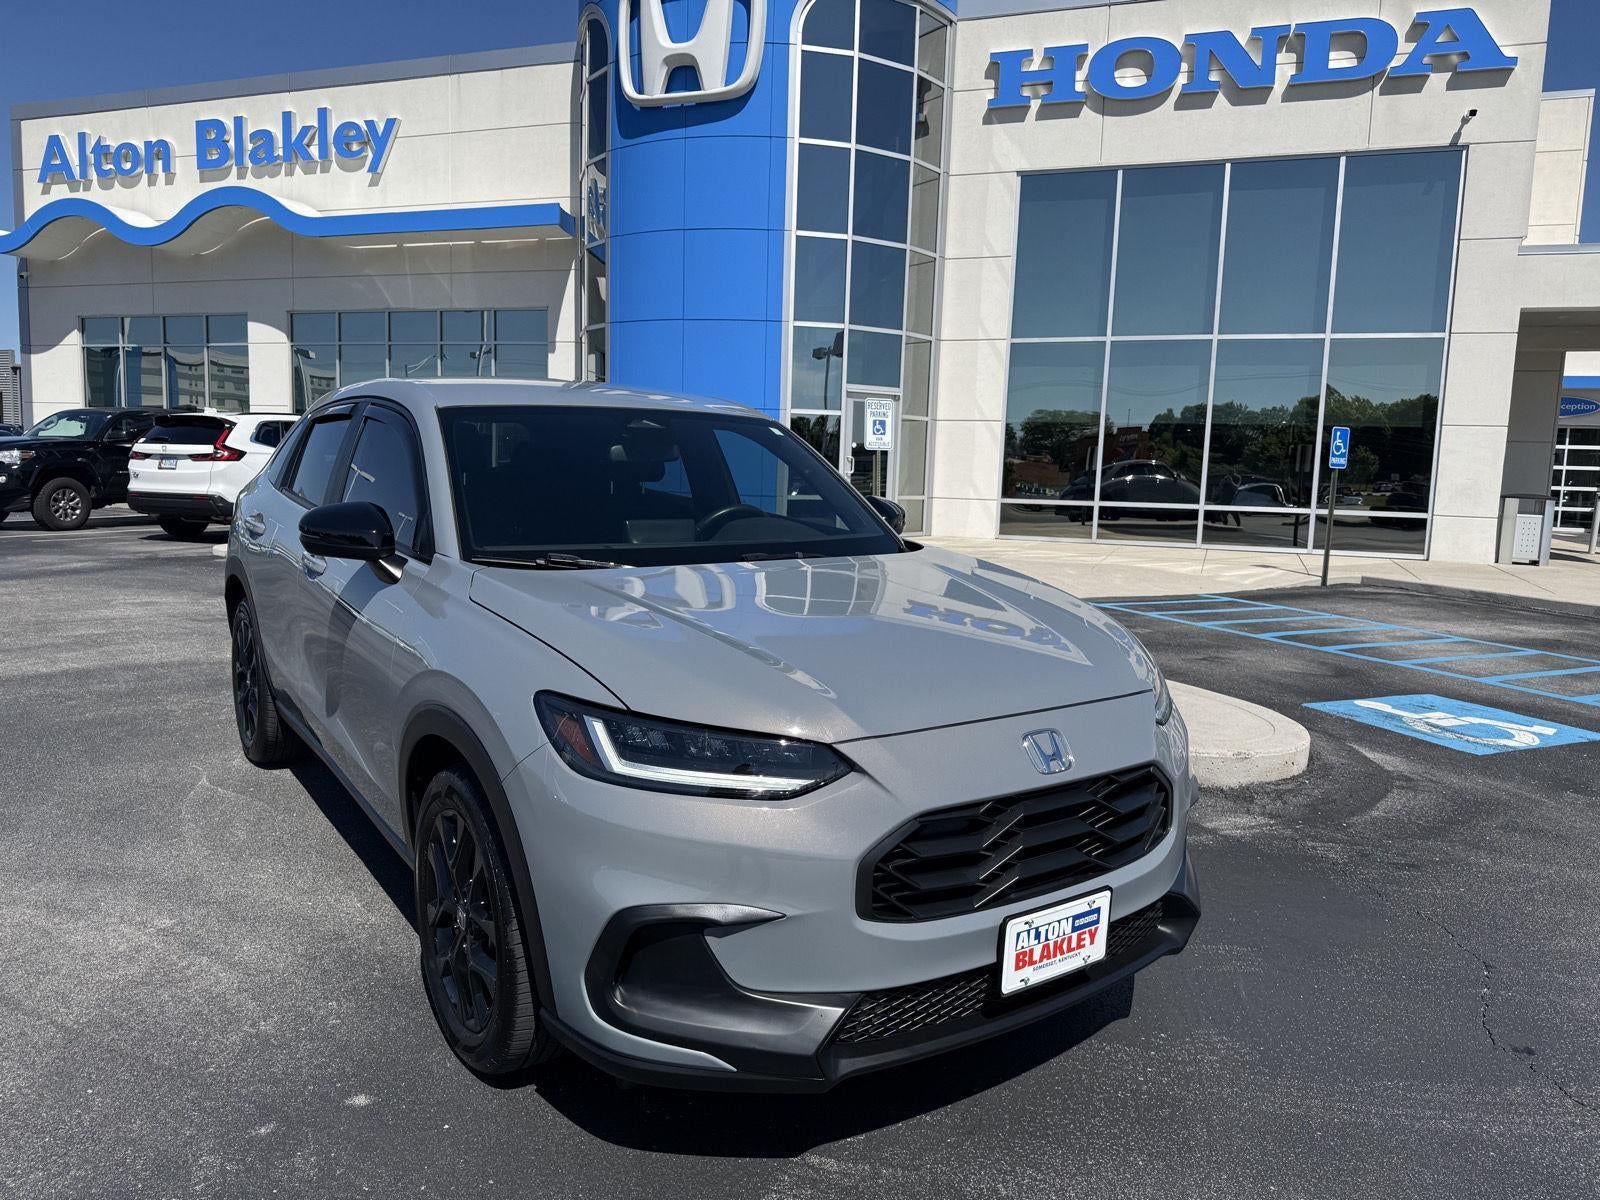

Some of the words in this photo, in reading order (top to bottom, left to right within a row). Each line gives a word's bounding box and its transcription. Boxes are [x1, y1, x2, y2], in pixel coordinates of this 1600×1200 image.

[987, 7, 1519, 109] HONDA
[37, 131, 174, 184] Alton
[195, 106, 401, 174] Blakley
[868, 402, 891, 410] RESERVED
[1561, 403, 1596, 411] ception
[1014, 926, 1100, 971] BLAKLEY
[1016, 917, 1073, 951] ALTON
[1032, 960, 1058, 972] SOMERSET,
[1058, 952, 1082, 964] KENTUCKY
